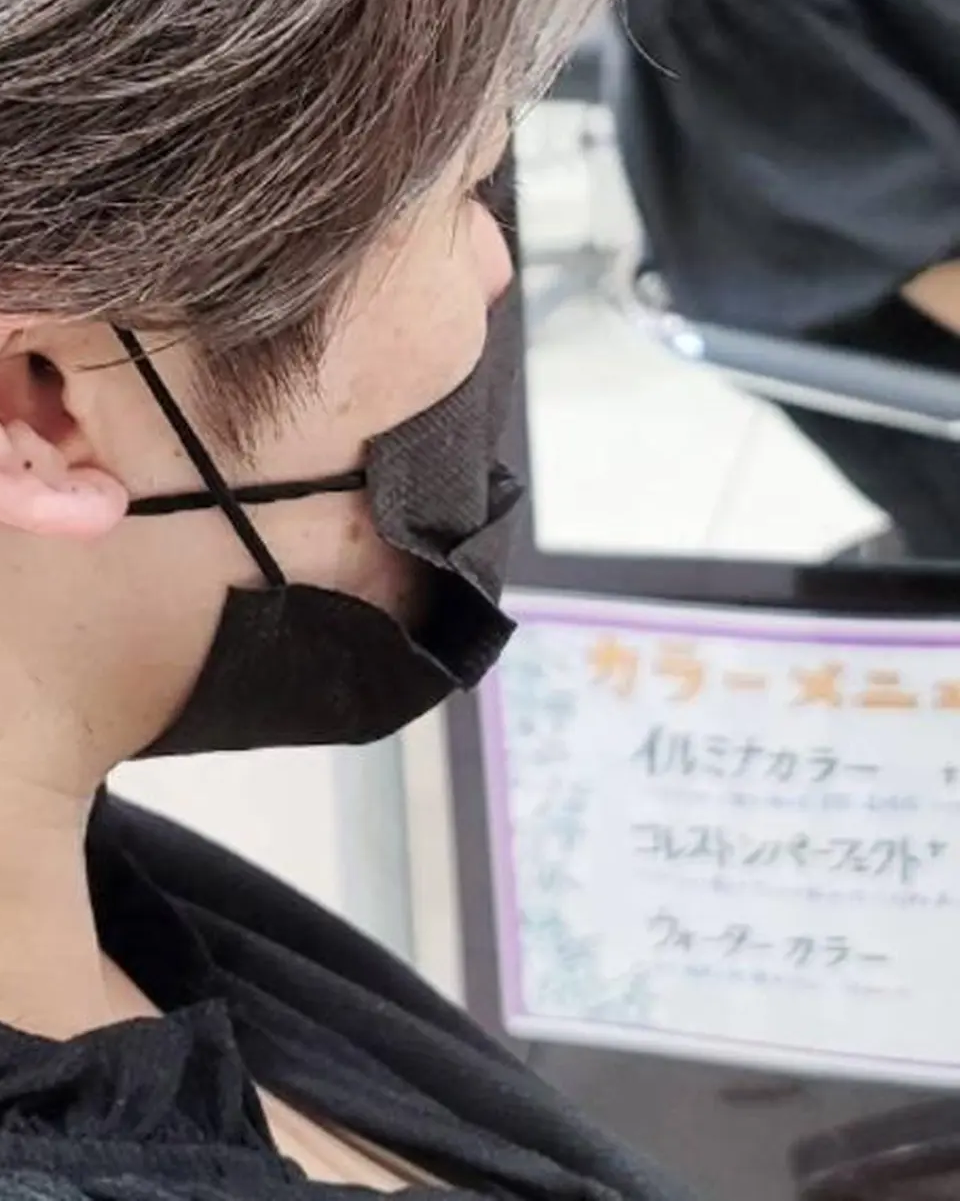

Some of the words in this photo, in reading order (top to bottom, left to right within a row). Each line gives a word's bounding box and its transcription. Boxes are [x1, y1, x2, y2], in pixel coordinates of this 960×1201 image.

[633, 723, 880, 781] イルミナカラー
